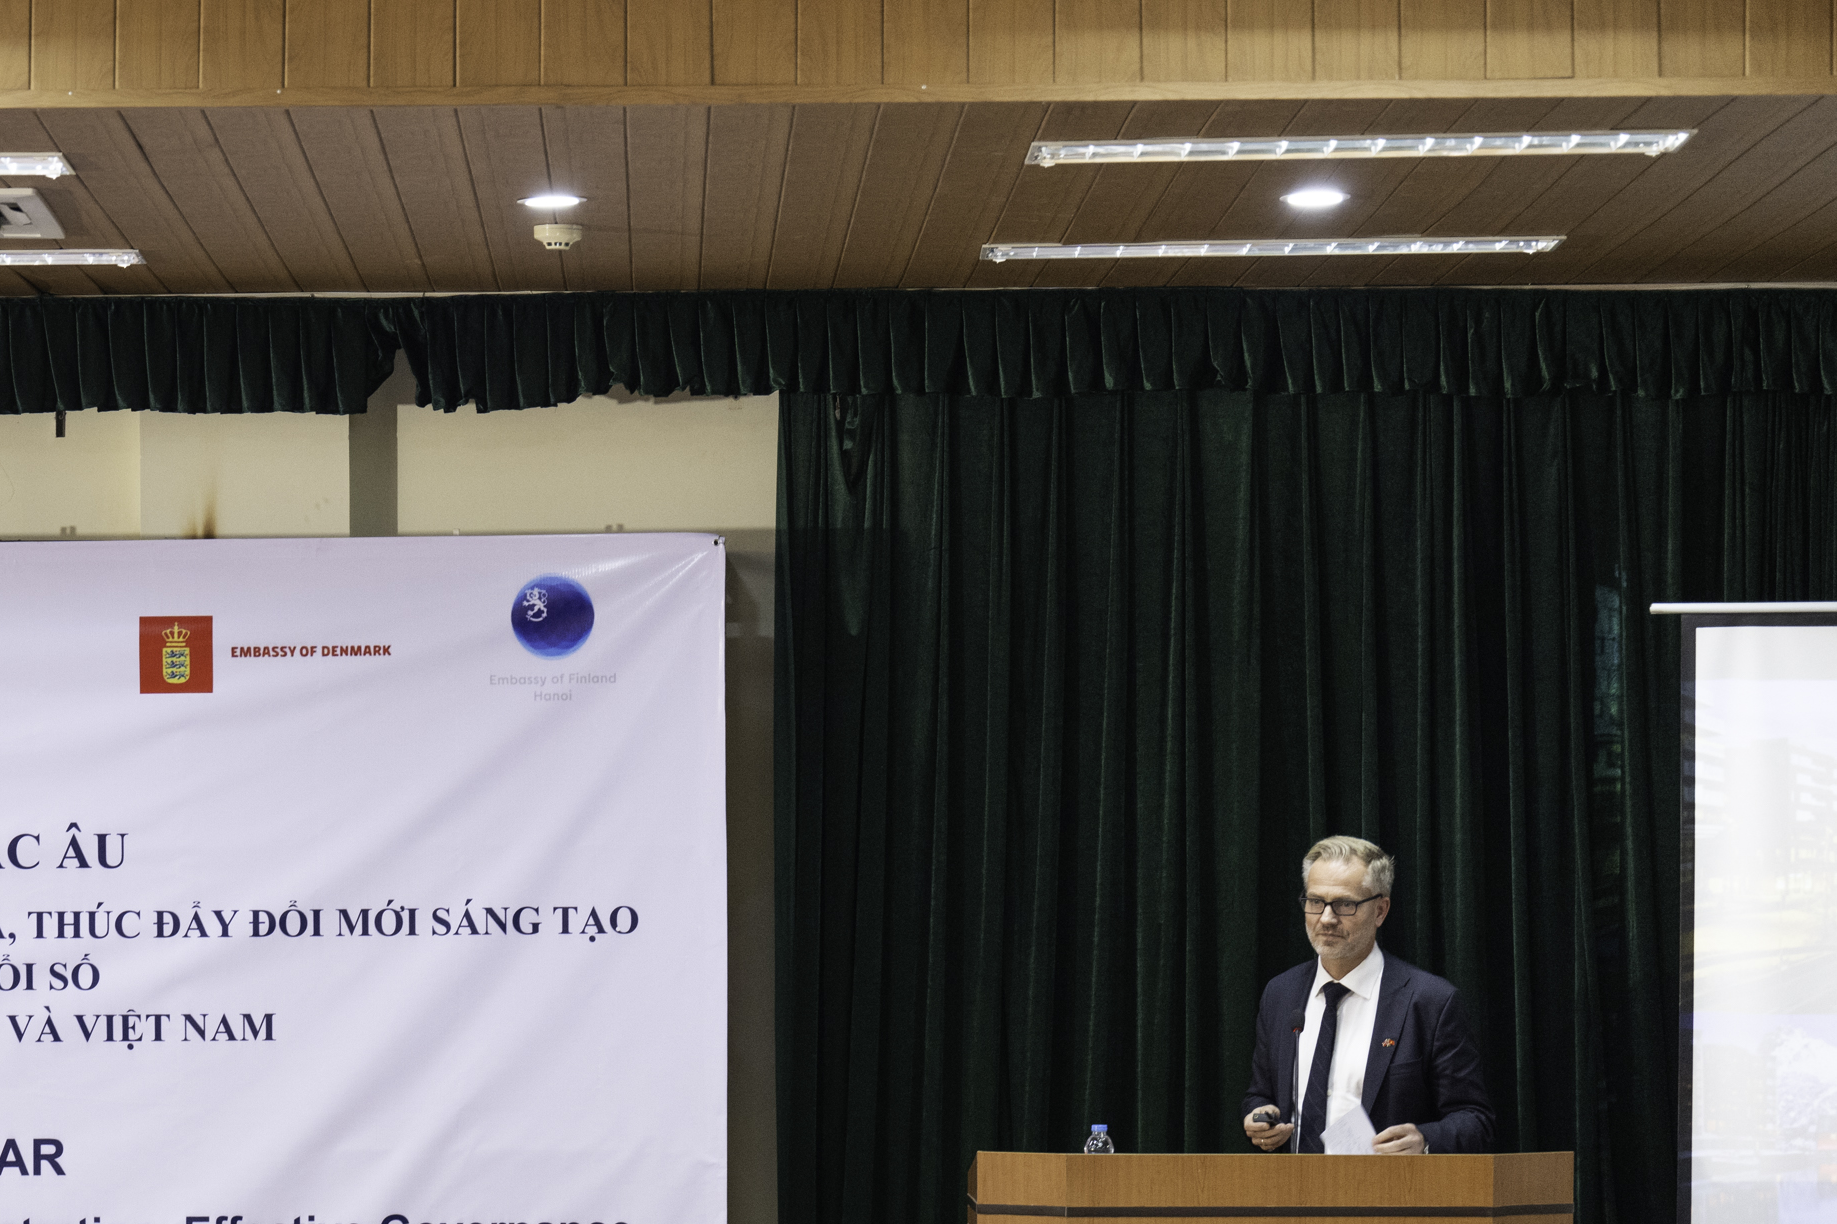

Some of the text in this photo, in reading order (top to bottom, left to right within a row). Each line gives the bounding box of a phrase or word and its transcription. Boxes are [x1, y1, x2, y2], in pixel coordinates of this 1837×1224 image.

[230, 644, 392, 658] EMBASSY OF DENMARK
[489, 672, 617, 687] Embassy of Finland
[533, 689, 573, 701] Hanoi
[55, 821, 128, 870] ÂU
[27, 901, 141, 940] THÚC
[152, 900, 240, 939] ĐẨY
[248, 900, 324, 938] ĐỔI
[335, 899, 420, 937] MỚI
[431, 899, 542, 937] SÁNG
[552, 905, 639, 943] TẠO
[49, 953, 100, 991] SỐ
[7, 1005, 64, 1043] VÀ
[73, 1008, 171, 1051] VIỆT
[181, 1013, 275, 1042] NAM
